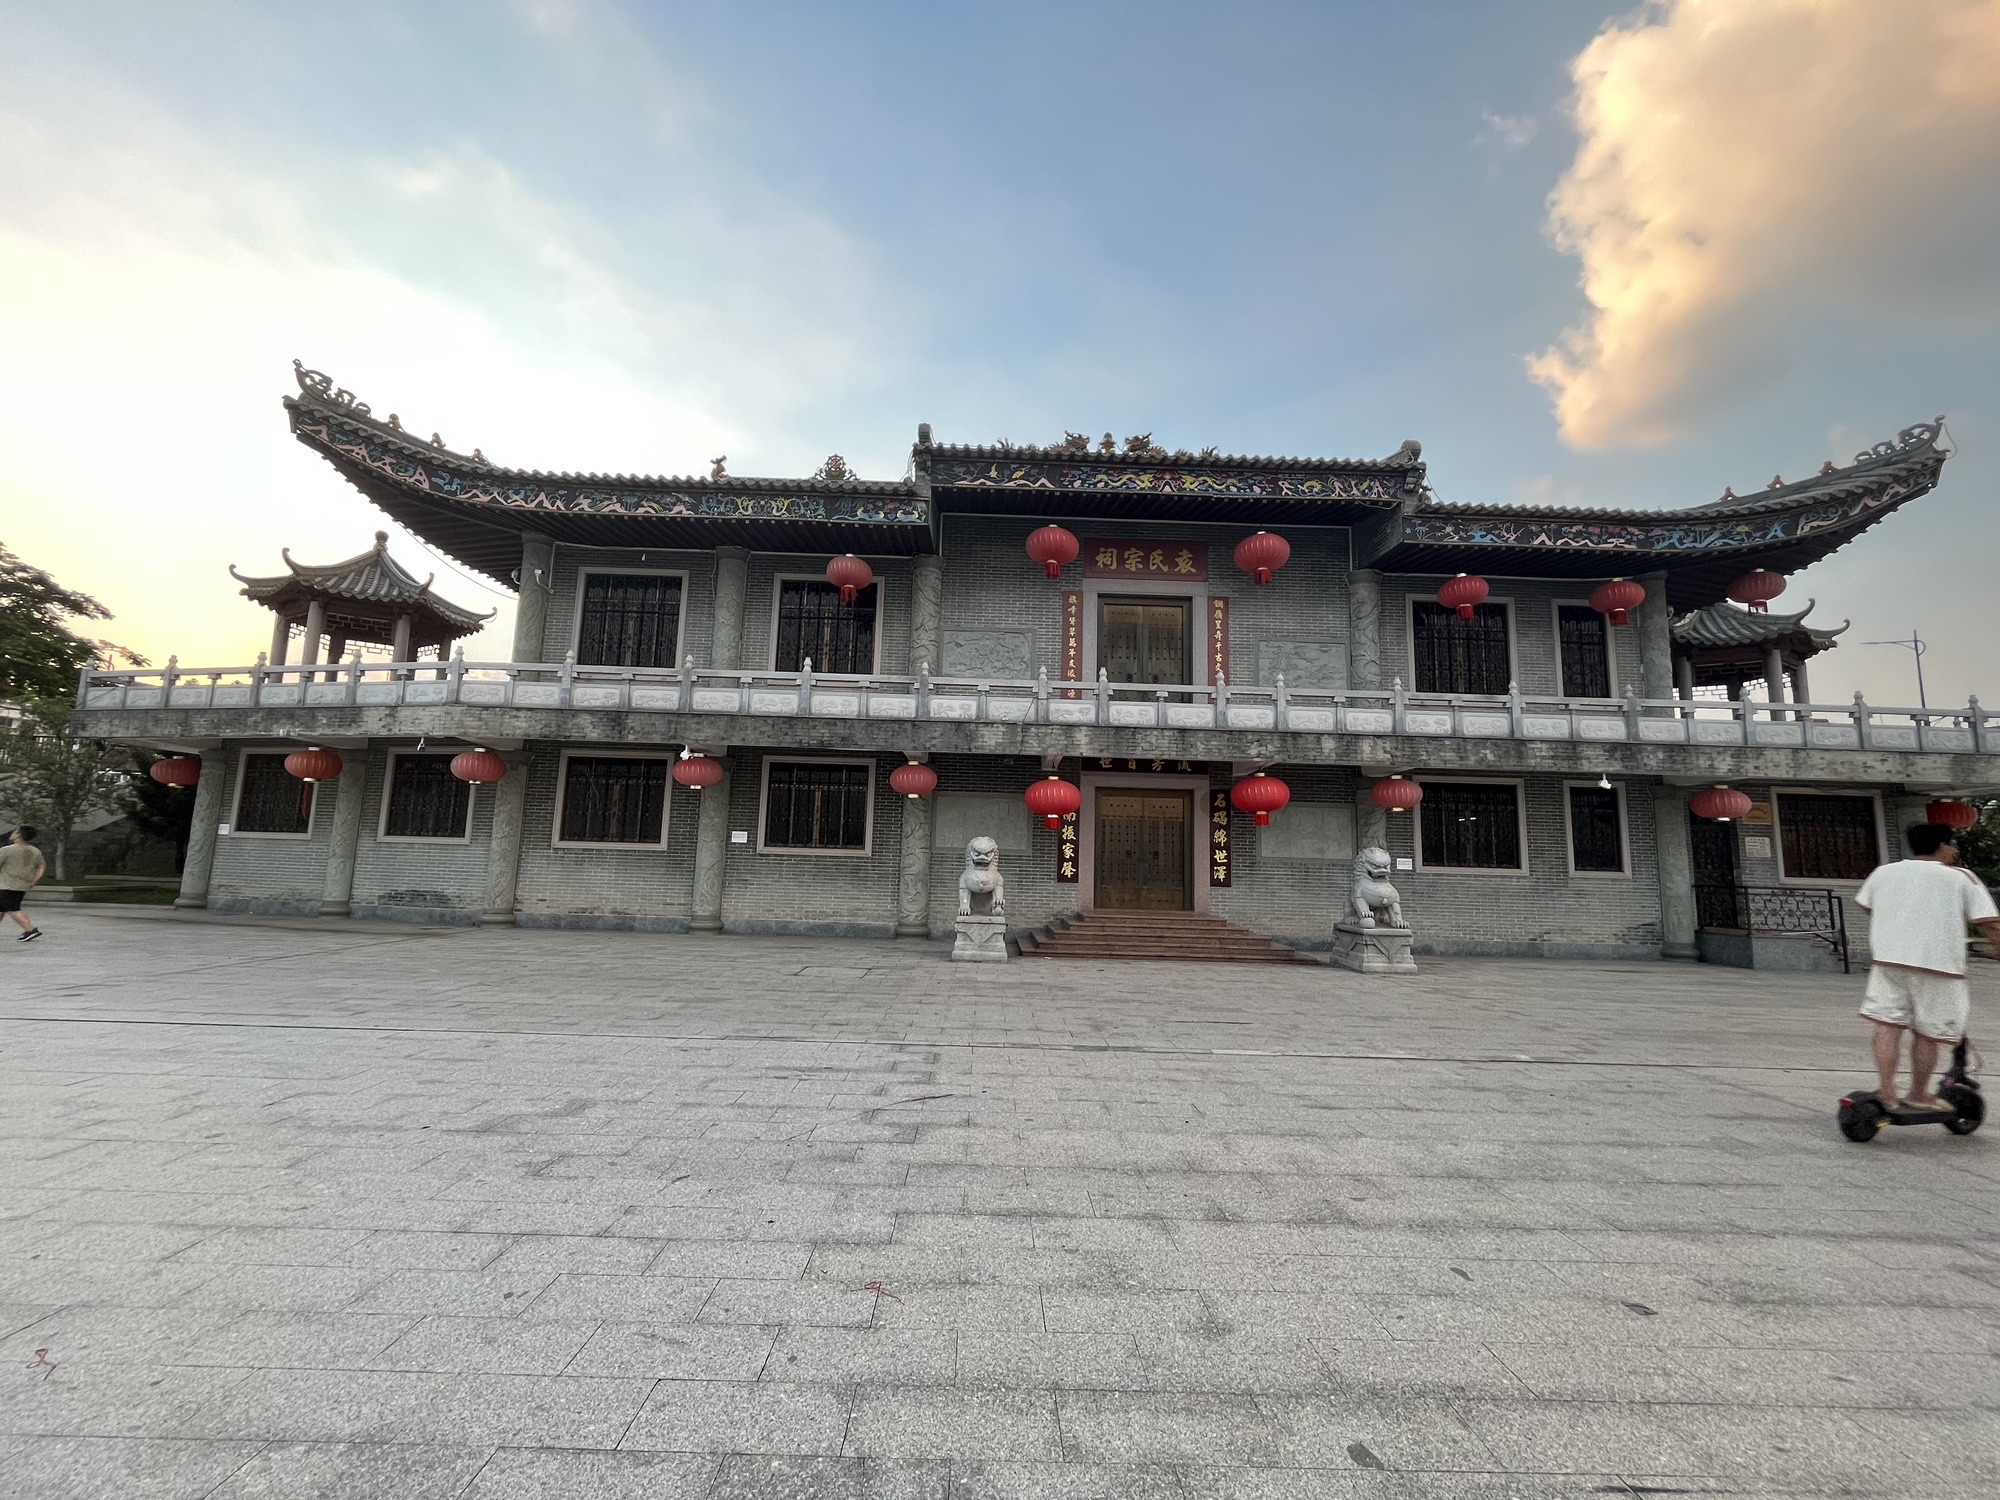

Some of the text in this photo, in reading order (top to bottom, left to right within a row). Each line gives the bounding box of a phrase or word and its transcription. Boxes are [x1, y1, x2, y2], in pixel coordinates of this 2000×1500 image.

[1094, 546, 1197, 575] 袁氏宗祠
[1060, 811, 1077, 879] 南振家聲
